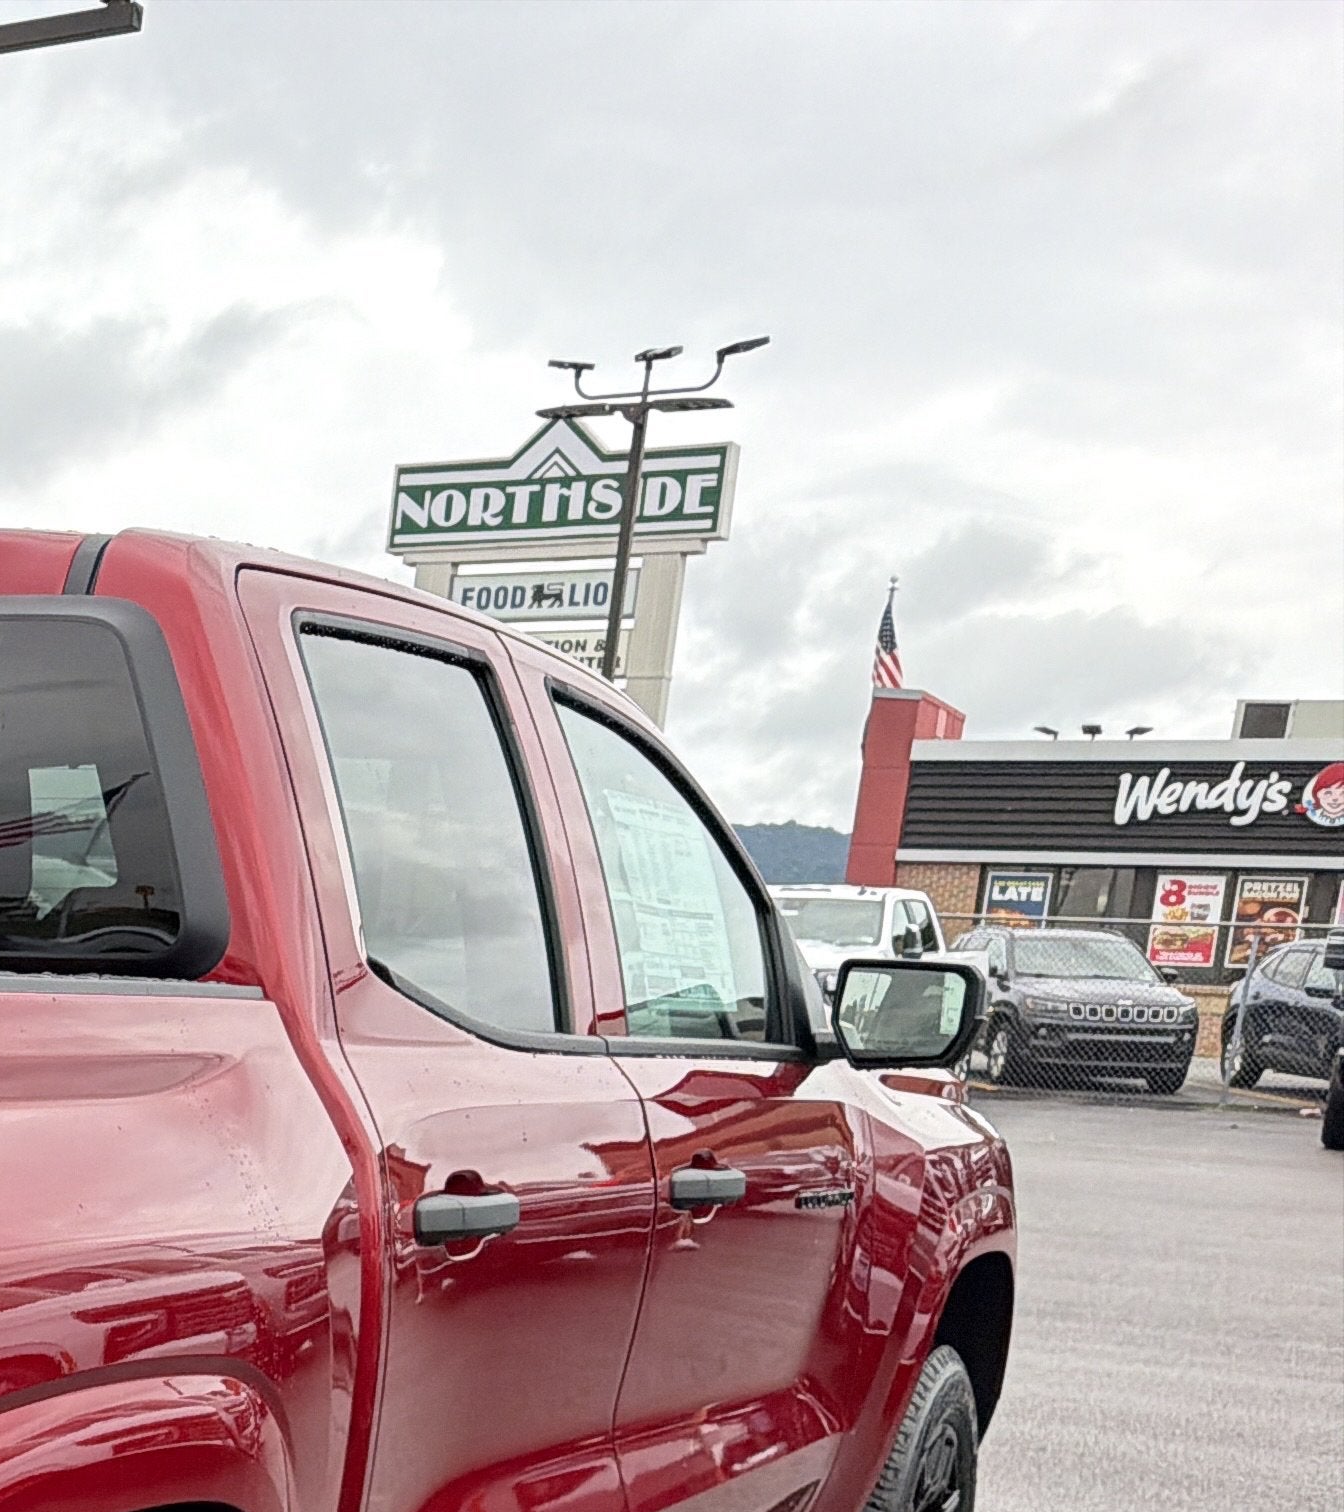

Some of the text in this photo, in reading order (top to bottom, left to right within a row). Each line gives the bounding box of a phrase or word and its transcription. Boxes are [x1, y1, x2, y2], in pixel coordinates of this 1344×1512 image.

[395, 473, 718, 529] NORTHSDE
[462, 581, 609, 610] FOOD LIO
[1114, 761, 1292, 826] Wendy's
[992, 886, 1044, 901] LATE
